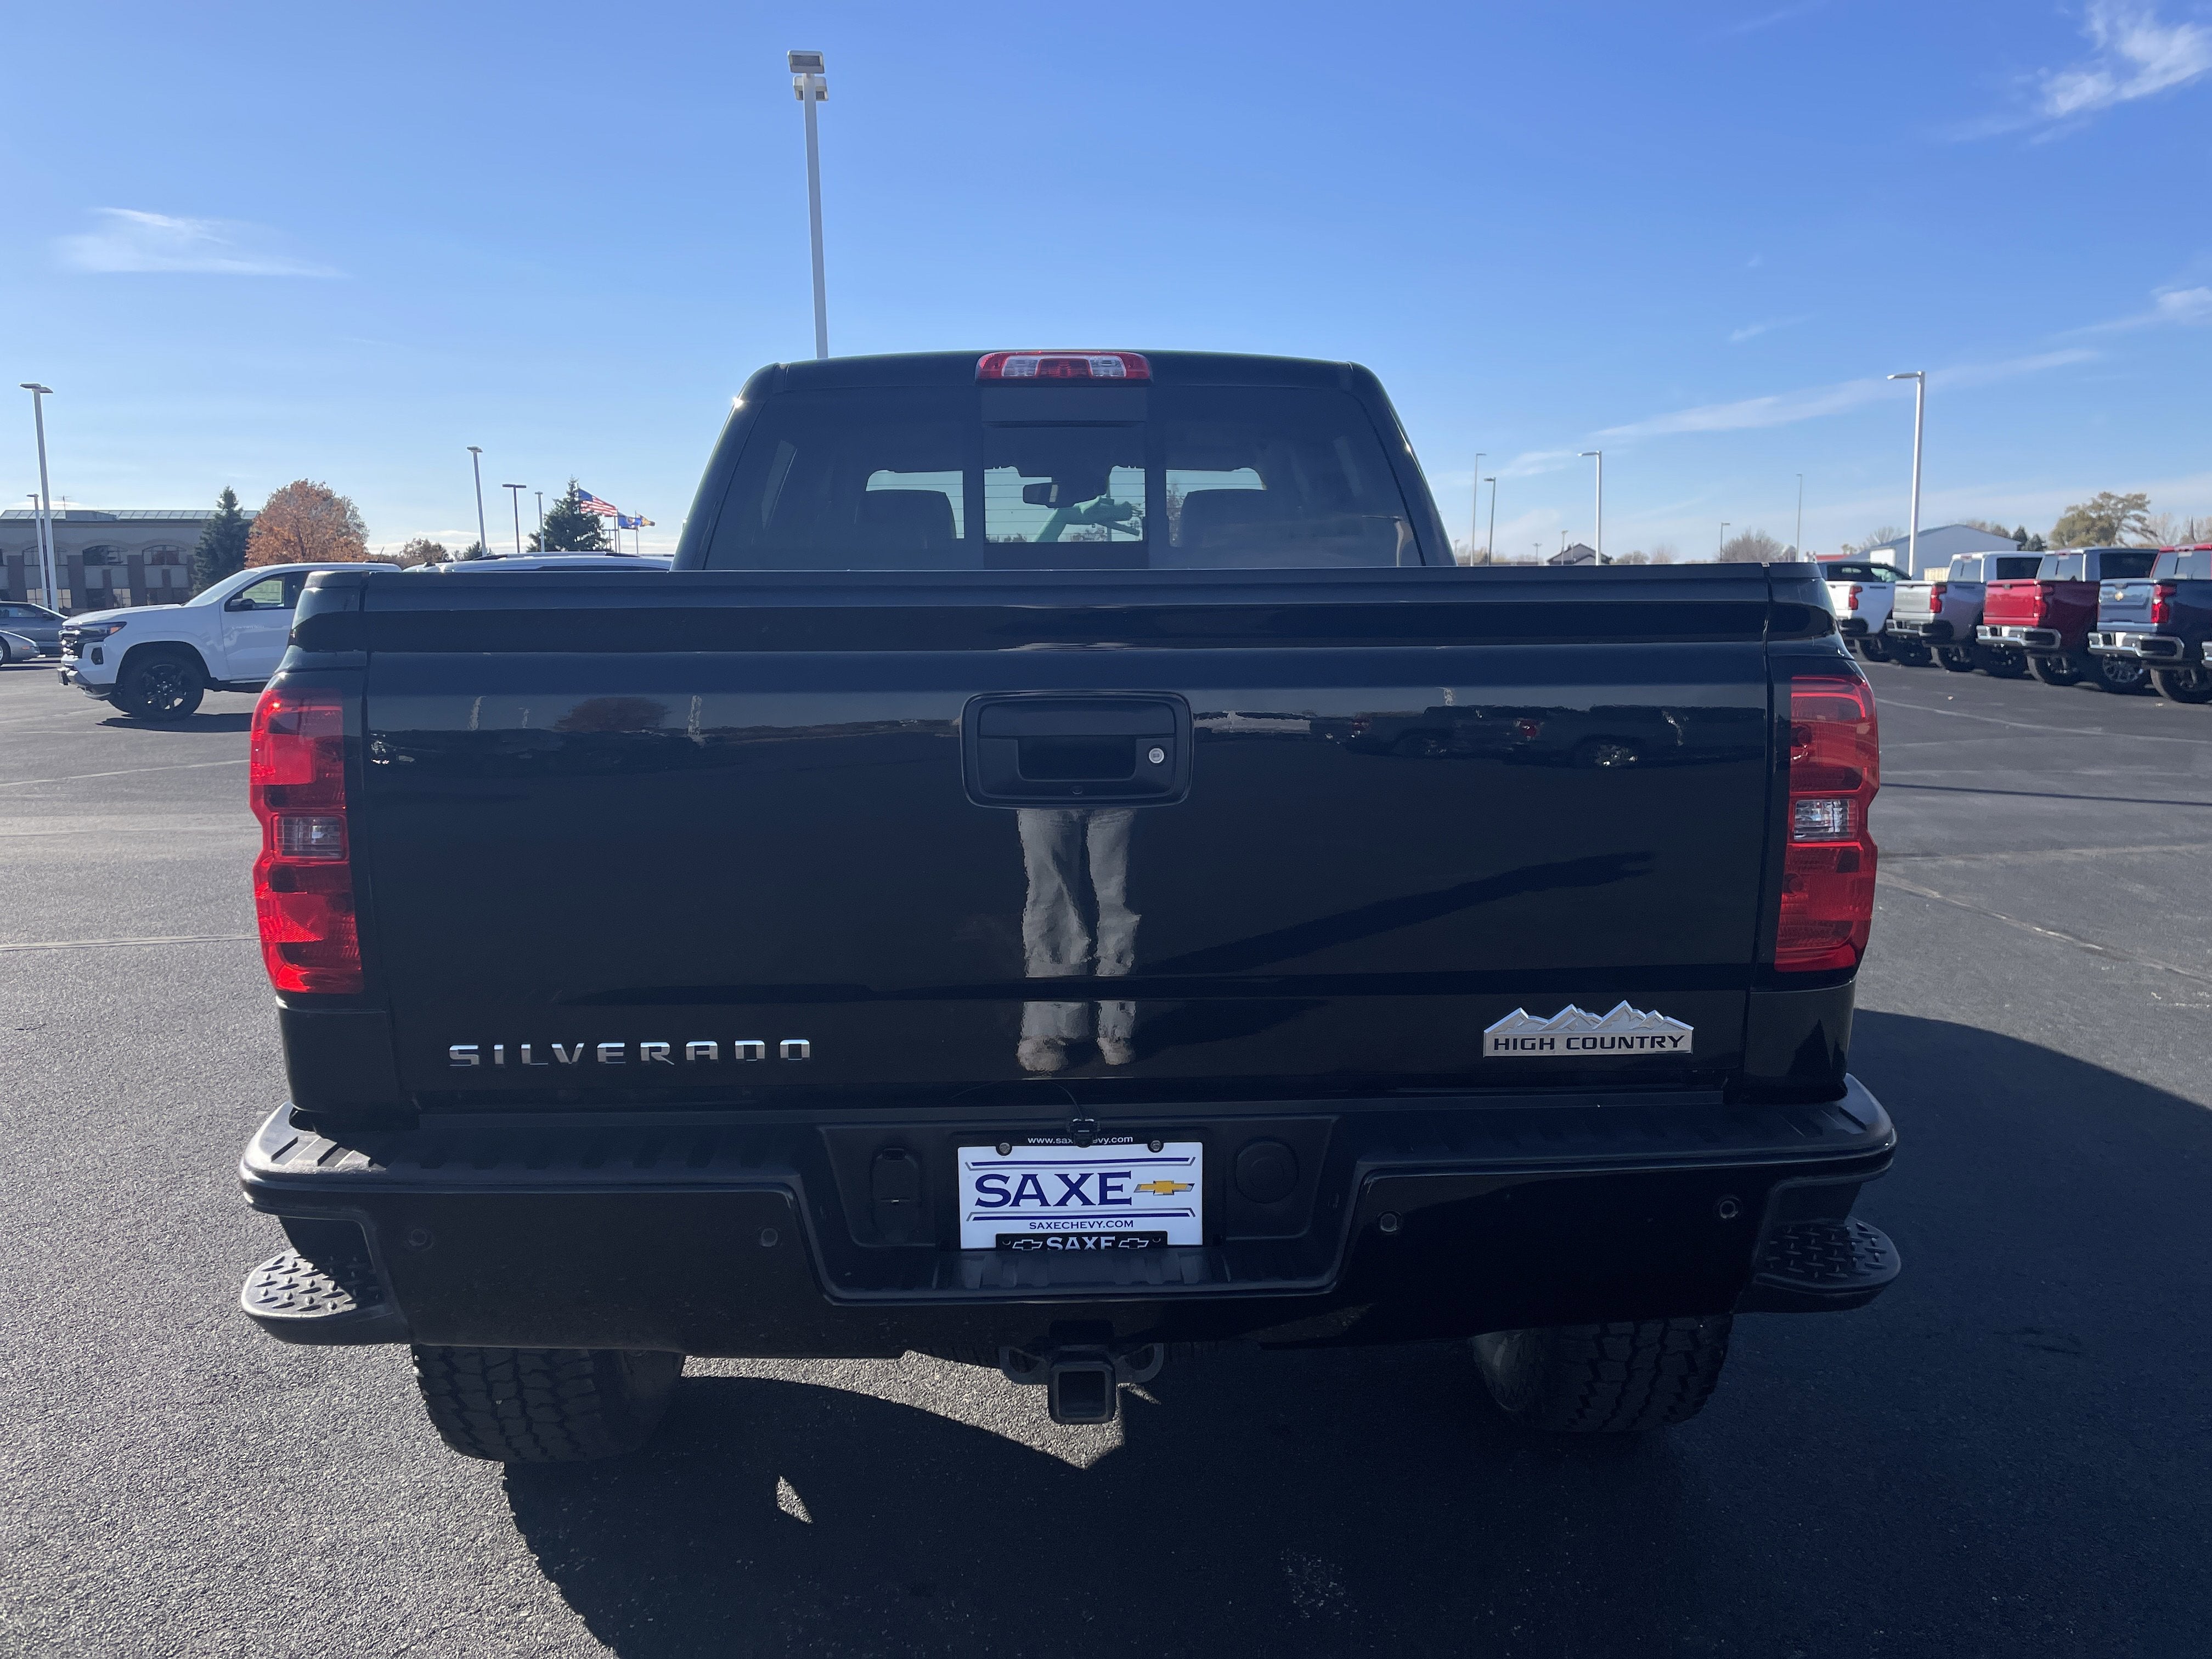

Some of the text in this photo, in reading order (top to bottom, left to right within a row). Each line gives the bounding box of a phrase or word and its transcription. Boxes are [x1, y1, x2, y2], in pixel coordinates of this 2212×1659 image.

[1494, 1035, 1685, 1050] HIGH COUNTRY
[449, 1039, 810, 1066] SILVERADO
[1028, 1136, 1133, 1145] www.saxevy.com
[975, 1171, 1132, 1207] SAXE
[1029, 1220, 1133, 1229] SAXECHEVY.COM
